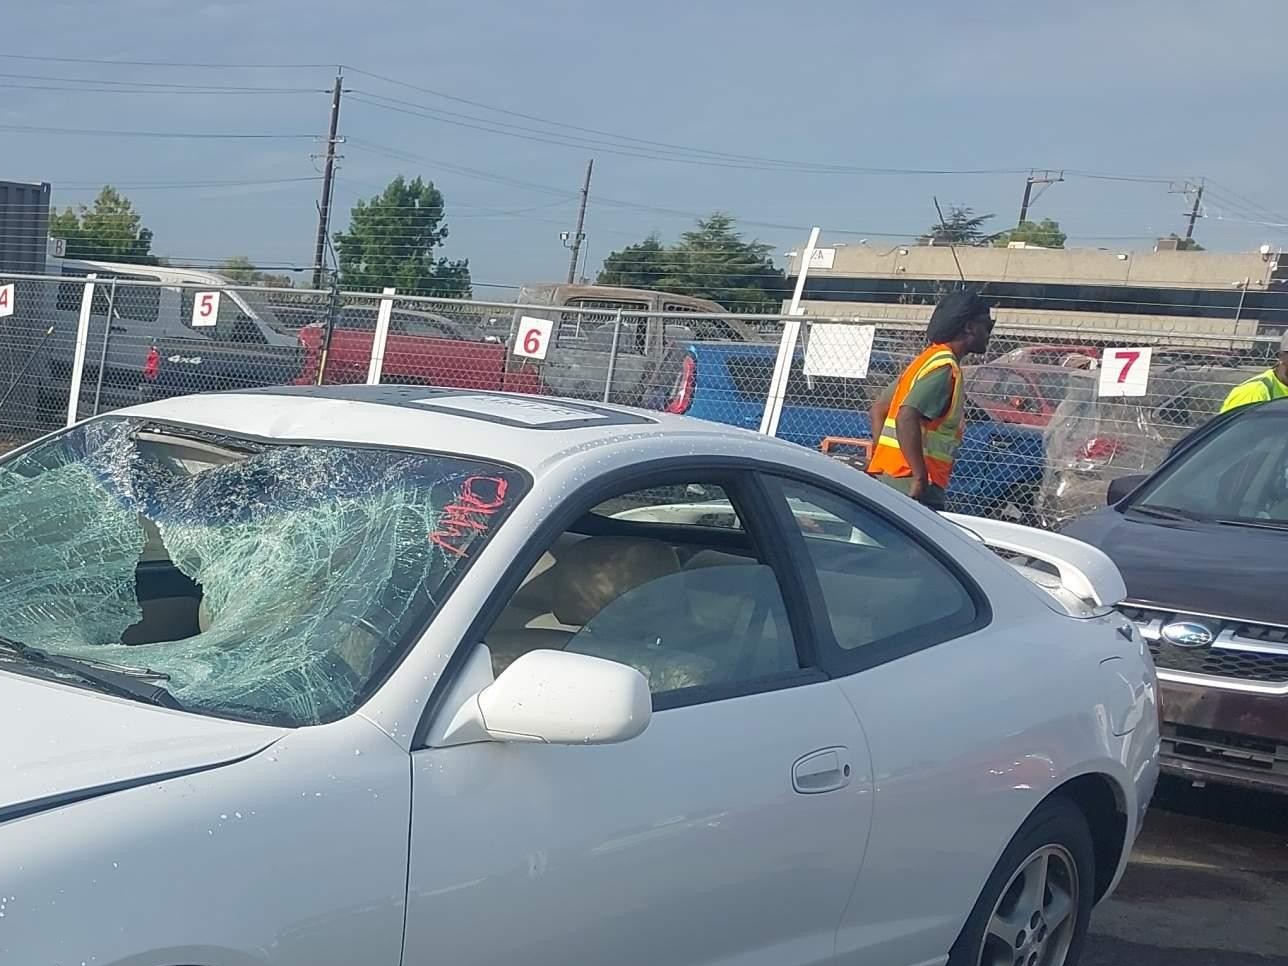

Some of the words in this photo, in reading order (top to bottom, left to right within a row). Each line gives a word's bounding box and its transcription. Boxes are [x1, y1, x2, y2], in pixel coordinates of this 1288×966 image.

[200, 294, 213, 317] 5
[523, 328, 542, 354] 6
[168, 355, 202, 365] 4x4
[1115, 351, 1141, 384] 7
